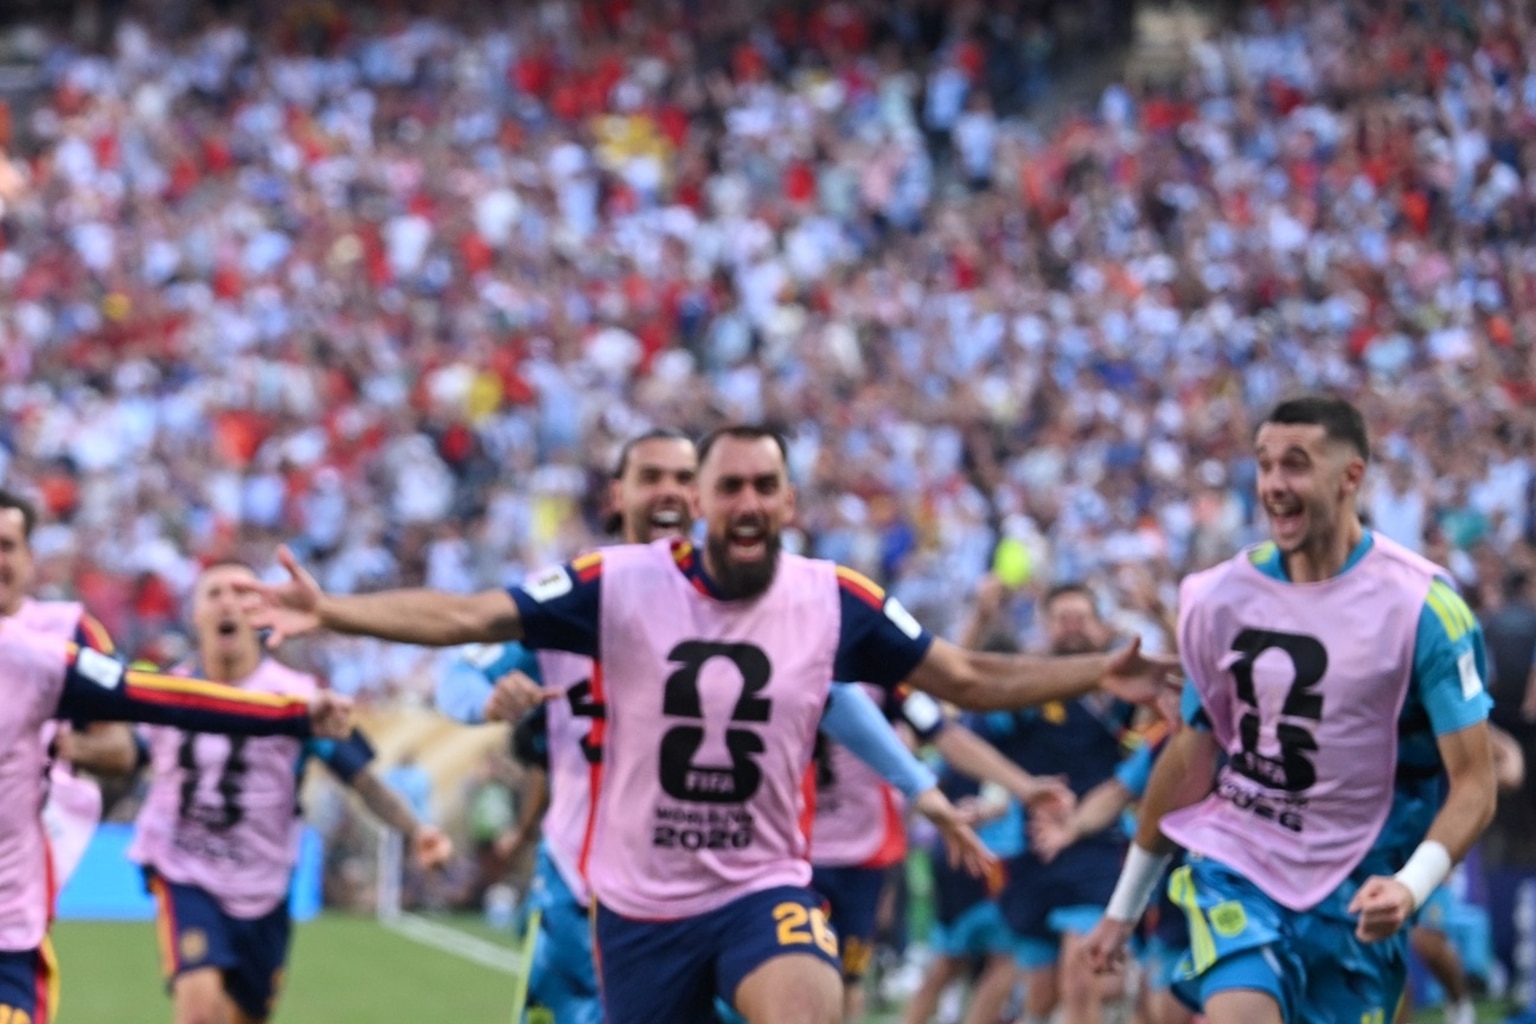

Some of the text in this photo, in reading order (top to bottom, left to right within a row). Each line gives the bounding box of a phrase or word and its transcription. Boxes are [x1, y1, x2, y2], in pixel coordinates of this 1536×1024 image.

[685, 770, 735, 792] FIFA
[653, 826, 753, 851] 2026
[771, 901, 839, 958] 26
